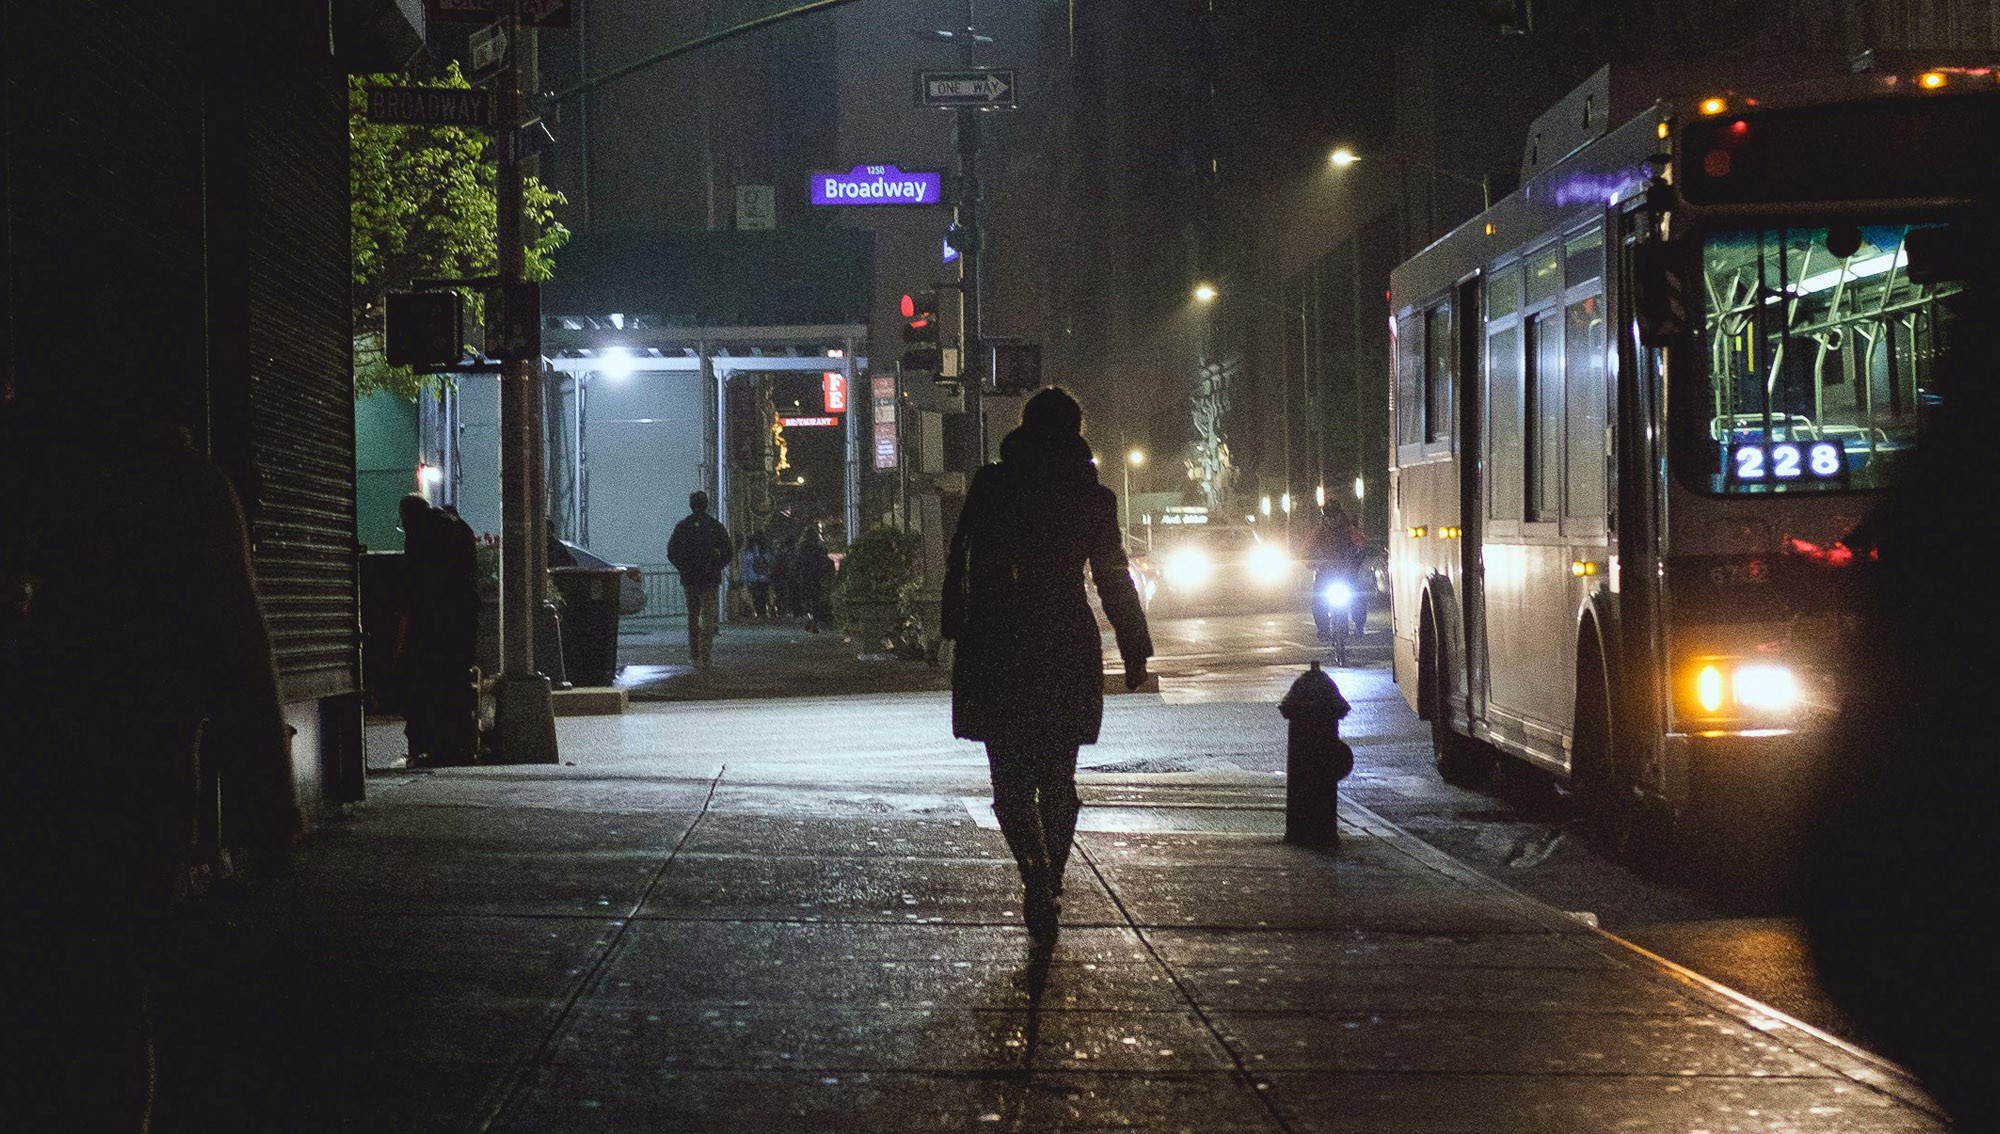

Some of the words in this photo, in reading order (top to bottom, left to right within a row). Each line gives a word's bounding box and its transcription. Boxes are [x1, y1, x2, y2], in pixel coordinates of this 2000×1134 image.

[937, 83, 961, 95] ONE
[973, 81, 999, 96] WAY
[373, 91, 482, 123] BROADWAY
[866, 165, 886, 177] 1250
[825, 177, 926, 203] Broadway
[1736, 443, 1839, 478] 228
